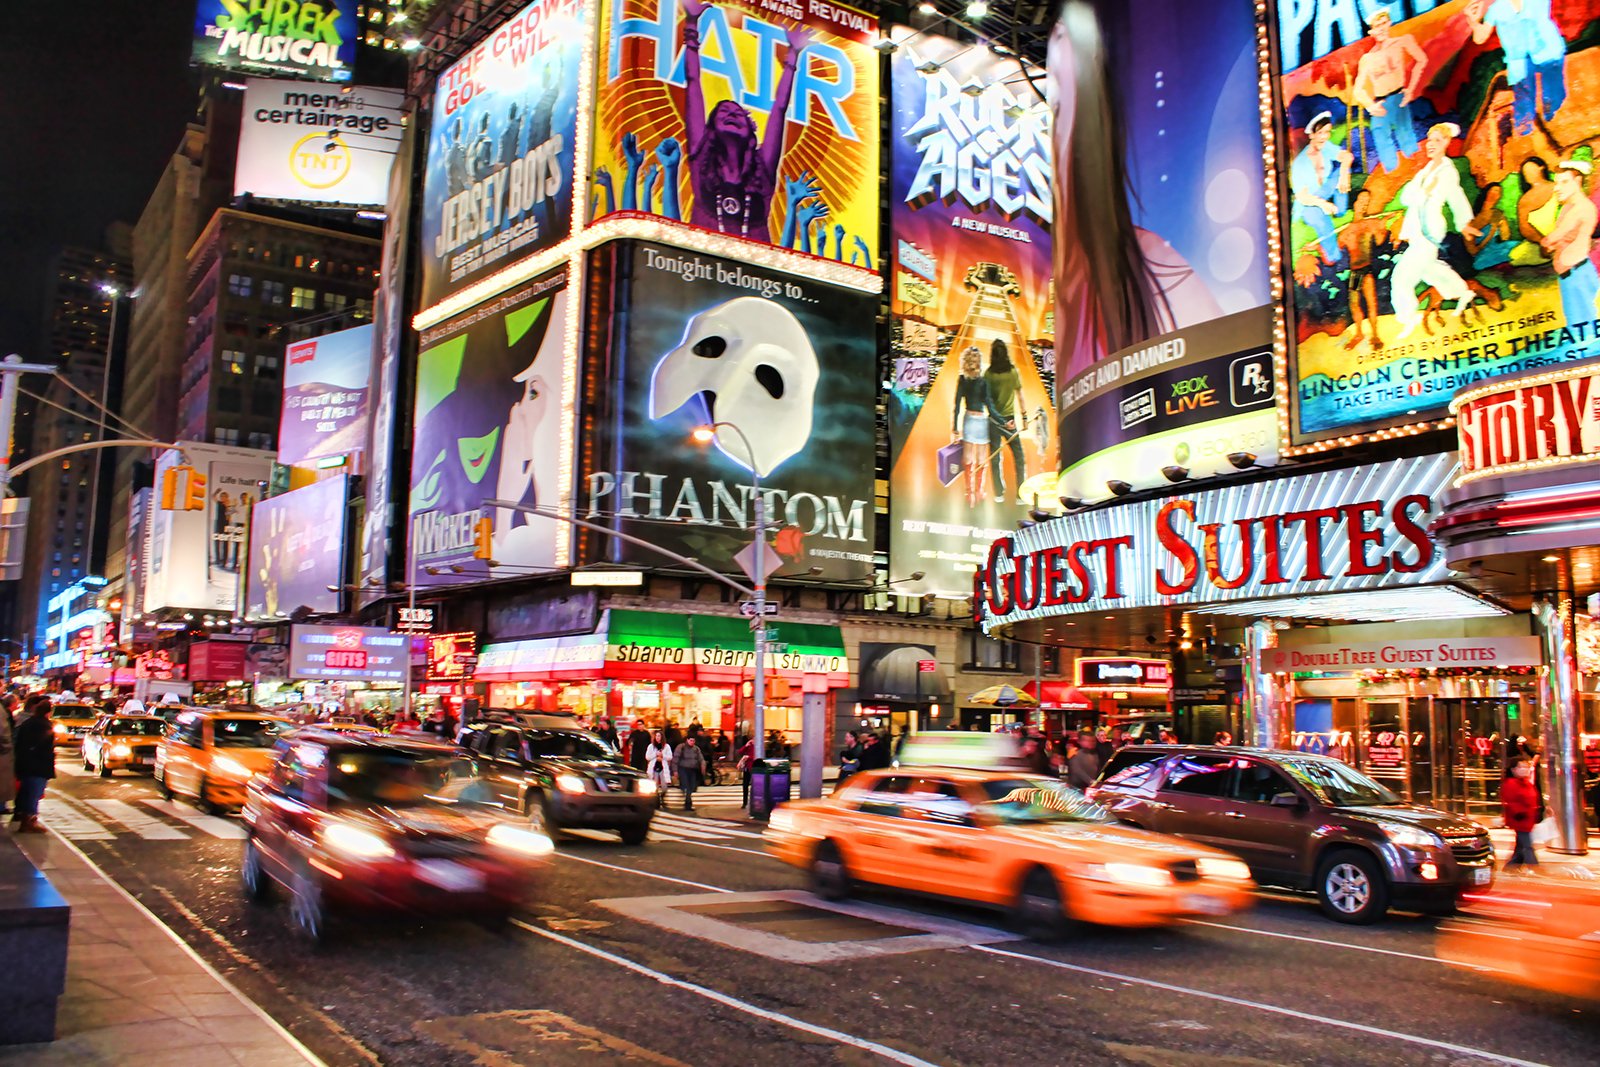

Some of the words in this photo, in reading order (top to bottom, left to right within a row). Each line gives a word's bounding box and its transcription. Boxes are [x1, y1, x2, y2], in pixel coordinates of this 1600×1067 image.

[216, 0, 343, 46] SHREK
[760, 0, 804, 20] AWARD
[809, 0, 873, 34] REVIVAL
[205, 25, 224, 38] THE
[217, 27, 343, 68] MUSICAL
[606, 0, 861, 142] HAIR
[284, 92, 338, 107] men
[346, 112, 389, 133] age
[299, 153, 342, 171] TNT
[905, 130, 1053, 223] AGES
[435, 167, 508, 258] JERSEY
[508, 133, 564, 219] BOYS
[451, 244, 482, 270] BEST
[482, 216, 539, 254] MUSICAL
[952, 217, 961, 228] A
[962, 218, 987, 233] NEW
[988, 223, 1032, 243] MUSICAL
[643, 248, 713, 282] Tonight
[716, 263, 782, 298] belongs
[1357, 344, 1414, 365] DIRECTED
[1421, 338, 1437, 351] BY
[1443, 320, 1514, 347] BARTLETT
[1518, 310, 1557, 332] SHER
[1062, 386, 1075, 411] THE
[1074, 371, 1097, 400] LOST
[1096, 360, 1120, 389] AND
[1122, 337, 1186, 376] DAMNED
[1171, 375, 1209, 397] XBOX
[1302, 366, 1391, 401] LINCOLN
[1400, 342, 1500, 380] CENTER
[1334, 392, 1372, 410] TAKE
[1376, 386, 1405, 402] THE
[1424, 366, 1493, 393] SUBWAY
[1497, 362, 1519, 375] TO
[1165, 389, 1217, 415] LIVE
[1460, 376, 1592, 472] STORY
[586, 471, 868, 542] PHANTOM
[984, 535, 1131, 615] GUEST
[1156, 495, 1434, 596] SUITES
[326, 651, 364, 667] GIFTS
[617, 642, 684, 664] sbarro
[702, 646, 755, 667] sbarr
[781, 650, 839, 672] sbo
